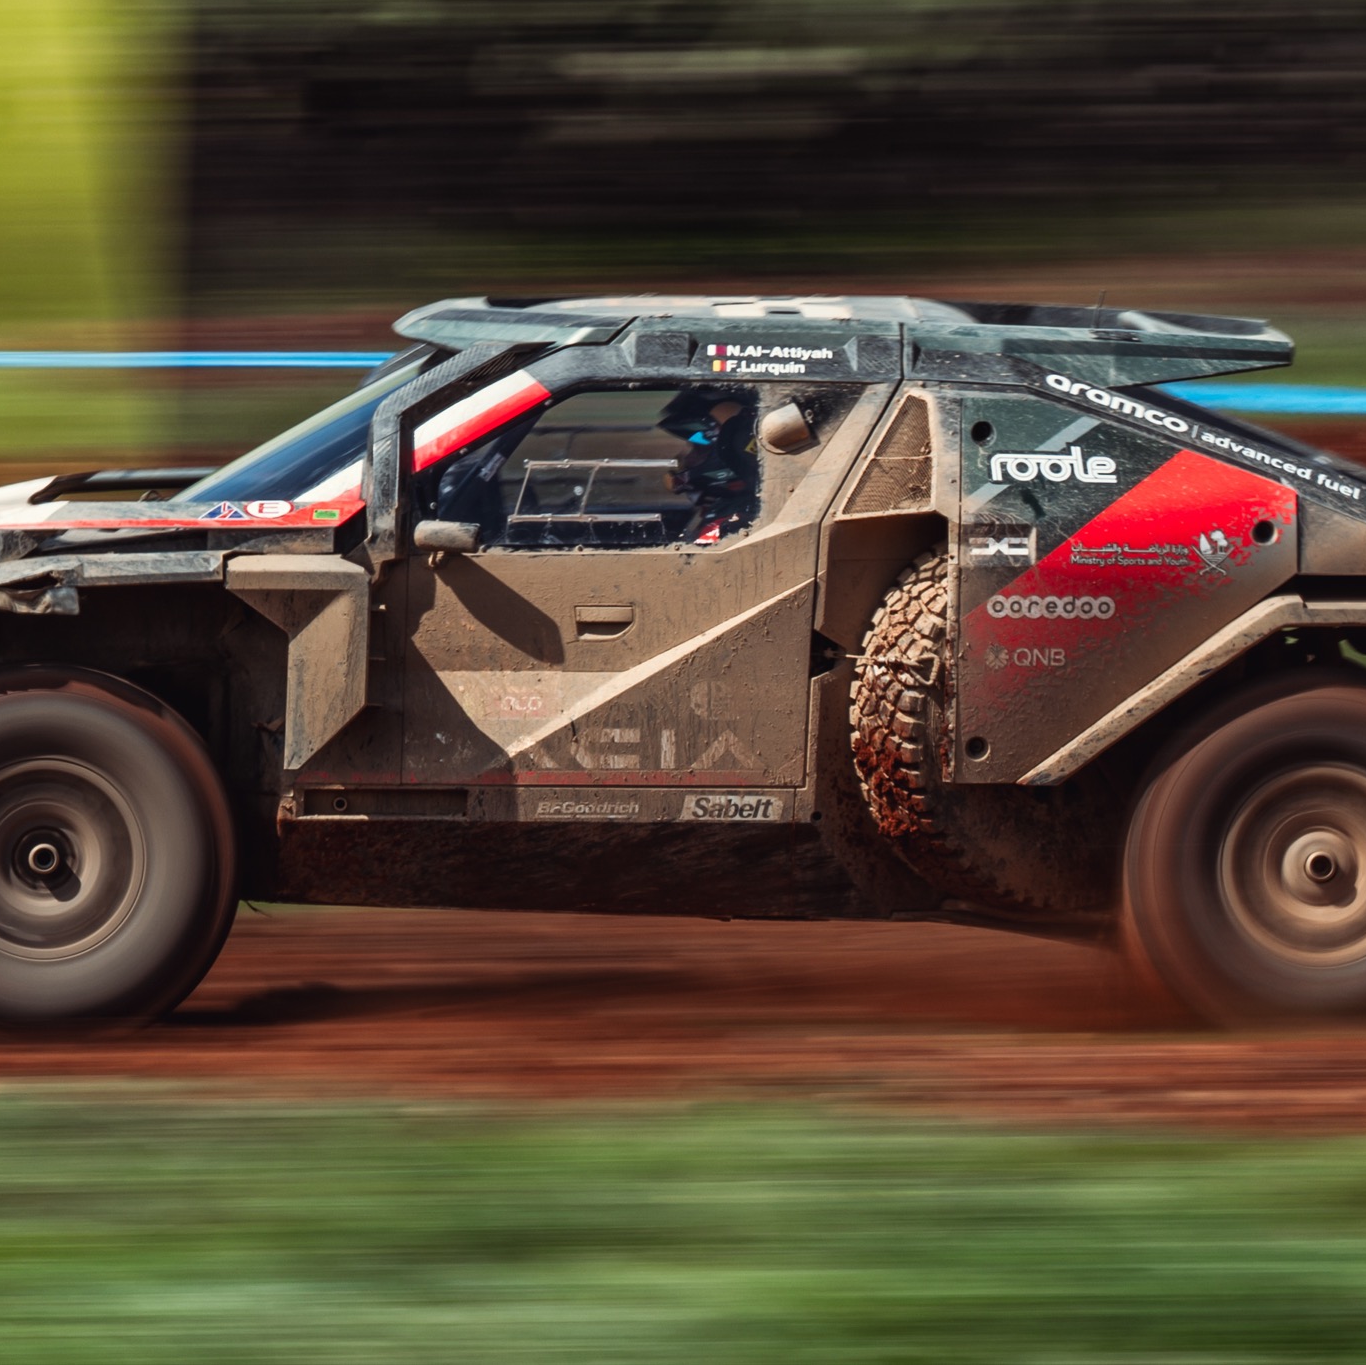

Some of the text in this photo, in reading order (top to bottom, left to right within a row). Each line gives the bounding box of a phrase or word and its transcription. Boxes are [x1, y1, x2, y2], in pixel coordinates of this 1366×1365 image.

[726, 345, 833, 360] N.Al-Attiyah
[726, 360, 805, 375] F.Lurquin
[1045, 374, 1361, 500] aramco advanced fuel
[990, 446, 1118, 484] roole
[1071, 556, 1105, 567] Ministry
[1107, 557, 1116, 565] of
[1117, 556, 1145, 566] Sports
[991, 596, 1112, 616] ooredoo
[1014, 648, 1065, 667] QNB
[691, 797, 773, 819] Sabelt
